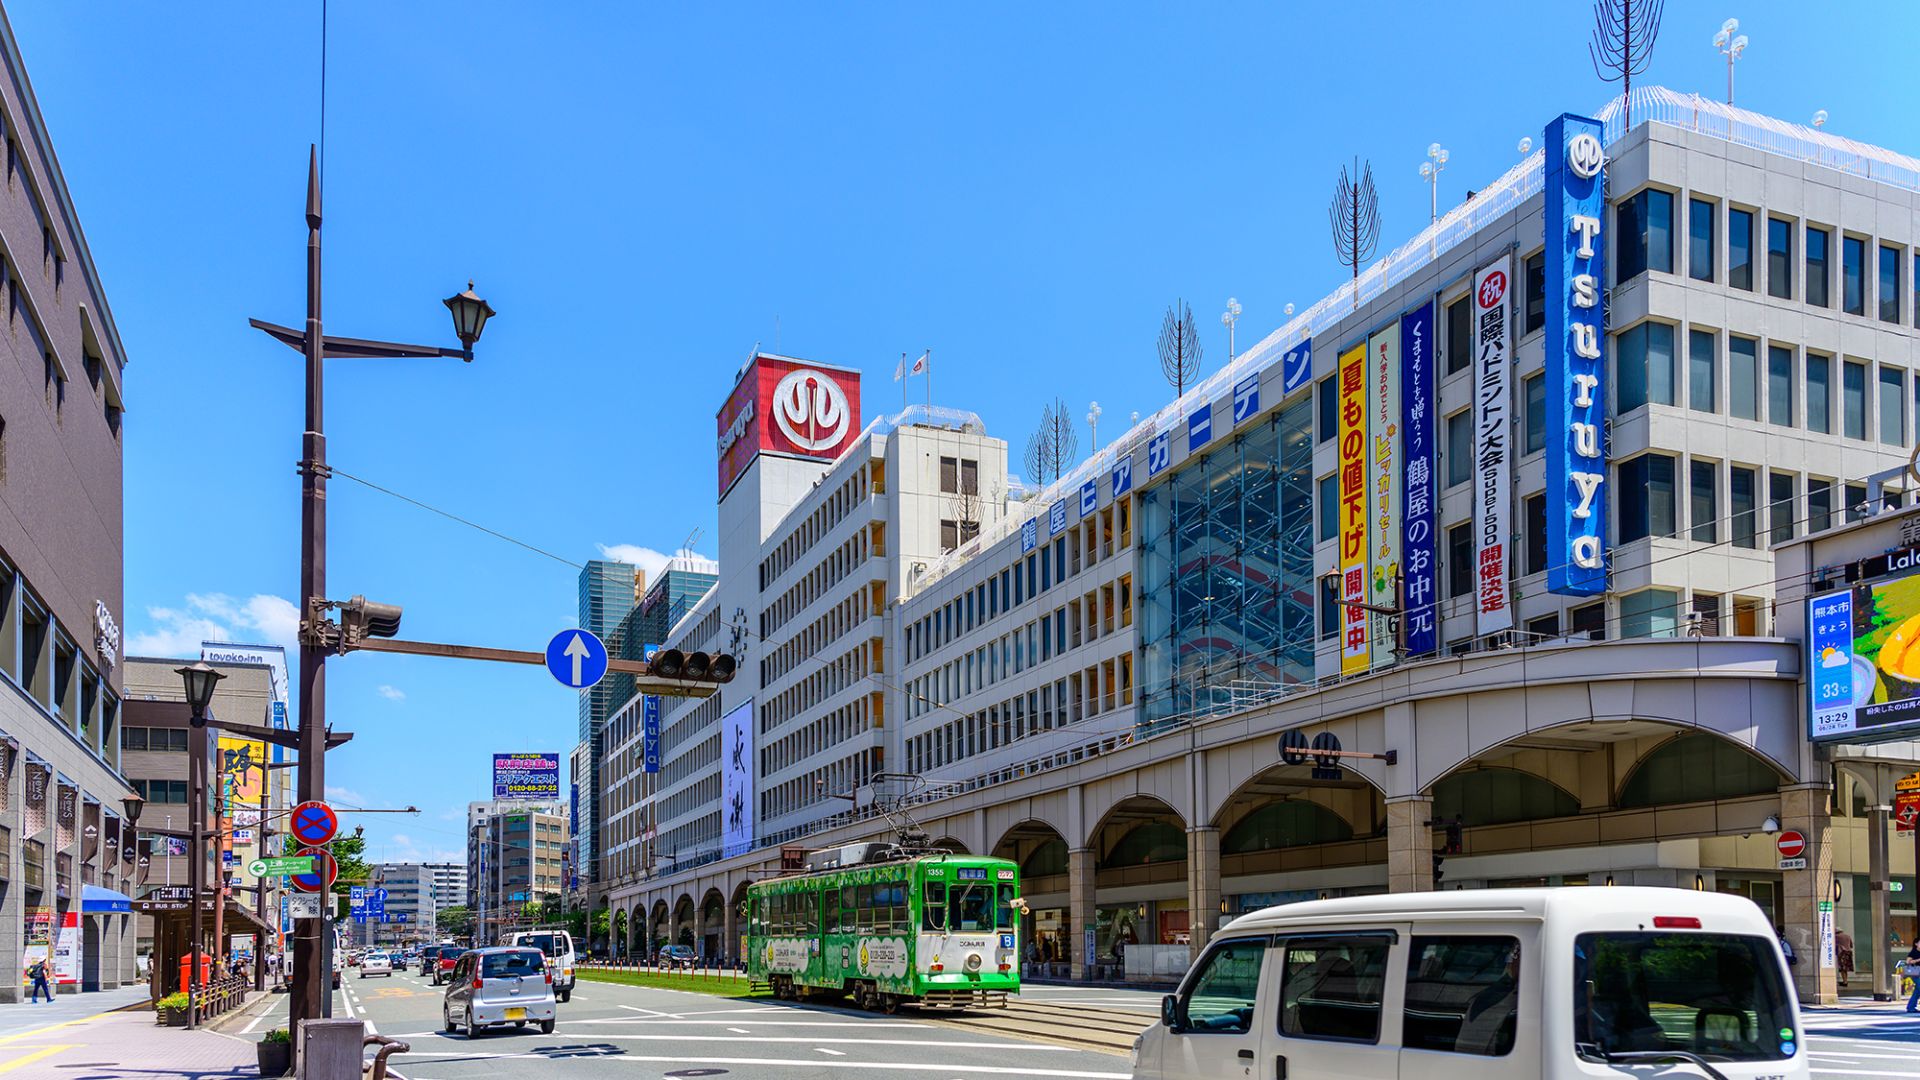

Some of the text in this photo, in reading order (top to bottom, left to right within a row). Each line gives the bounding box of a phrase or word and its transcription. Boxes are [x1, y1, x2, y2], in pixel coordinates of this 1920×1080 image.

[1482, 280, 1502, 300] 祝
[1569, 215, 1605, 570] Tsuruya
[1020, 338, 1311, 554] 鶴屋ビアガーデン
[1342, 358, 1364, 559] 夏もの値下げ
[1406, 455, 1432, 638] 鶴屋のお中元
[1345, 567, 1365, 651] 開催中
[1814, 602, 1849, 619] 熊本市
[1818, 621, 1848, 635] きょう
[1818, 712, 1848, 724] 13:29
[292, 896, 335, 905] タクシーのち
[1004, 936, 1011, 947] B
